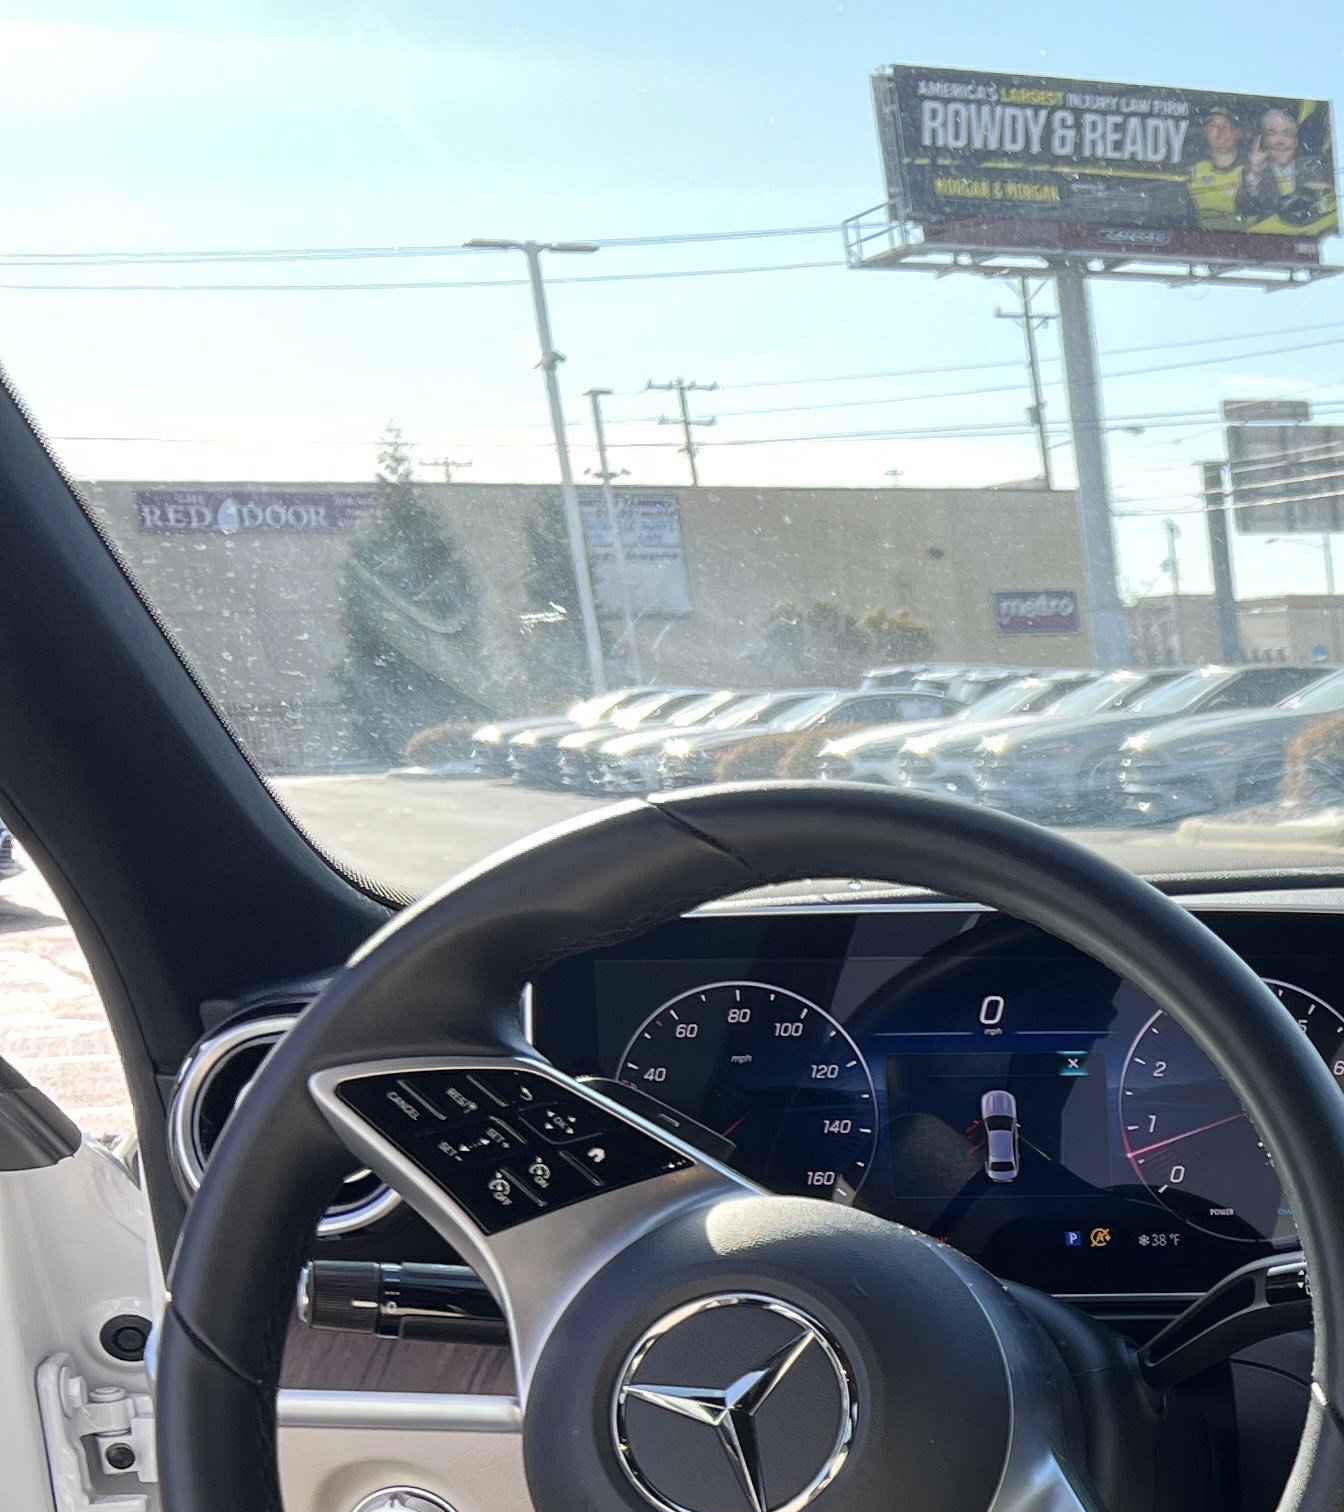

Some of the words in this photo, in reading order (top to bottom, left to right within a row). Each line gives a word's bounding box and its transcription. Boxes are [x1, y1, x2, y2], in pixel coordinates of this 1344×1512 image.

[921, 100, 1048, 154] ROWDY
[1051, 109, 1077, 156] &
[1082, 112, 1189, 164] READY
[141, 505, 212, 529] RED
[239, 504, 329, 529] DOOR
[728, 1009, 750, 1023] 80
[980, 995, 1005, 1025] 0
[675, 1024, 698, 1038] 60
[774, 1023, 803, 1037] 100
[731, 1054, 752, 1064] mph
[643, 1068, 666, 1082] 40
[811, 1064, 839, 1079] 120
[1153, 1061, 1166, 1077] 2
[823, 1120, 851, 1134] 140
[1148, 1115, 1157, 1133] 1
[807, 1171, 835, 1186] 160
[1170, 1165, 1185, 1183] 0
[1210, 1208, 1234, 1216] POWER
[1069, 1232, 1077, 1244] P
[1151, 1234, 1167, 1246] 38
